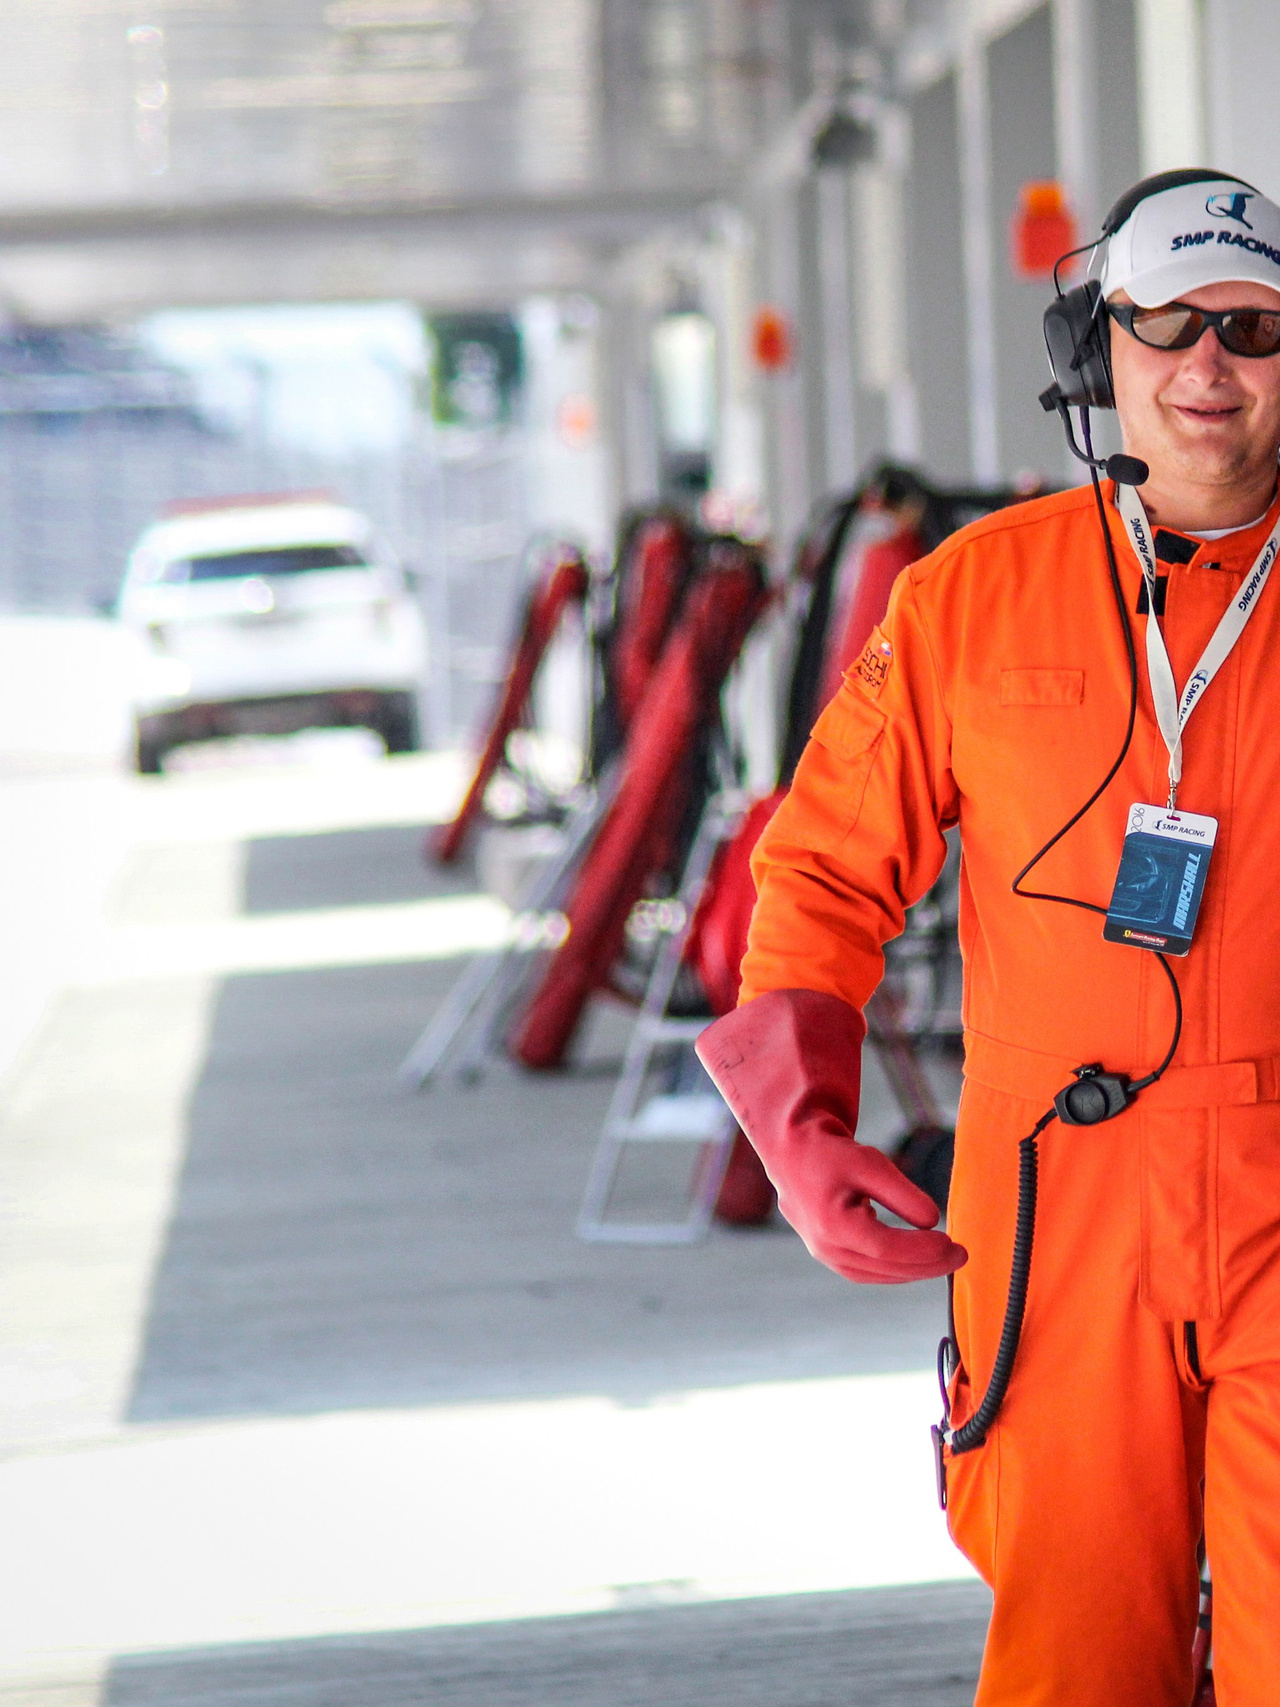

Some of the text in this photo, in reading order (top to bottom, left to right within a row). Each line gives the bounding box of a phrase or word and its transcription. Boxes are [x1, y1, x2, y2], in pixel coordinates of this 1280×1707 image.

[1171, 230, 1214, 251] SMP
[1130, 518, 1149, 554] RACING
[1238, 550, 1272, 612] SMP RACING
[1185, 682, 1200, 706] SMP
[1131, 807, 1146, 833] 2016
[1161, 823, 1206, 838] SMP RACING
[1172, 852, 1202, 931] MARSHALL
